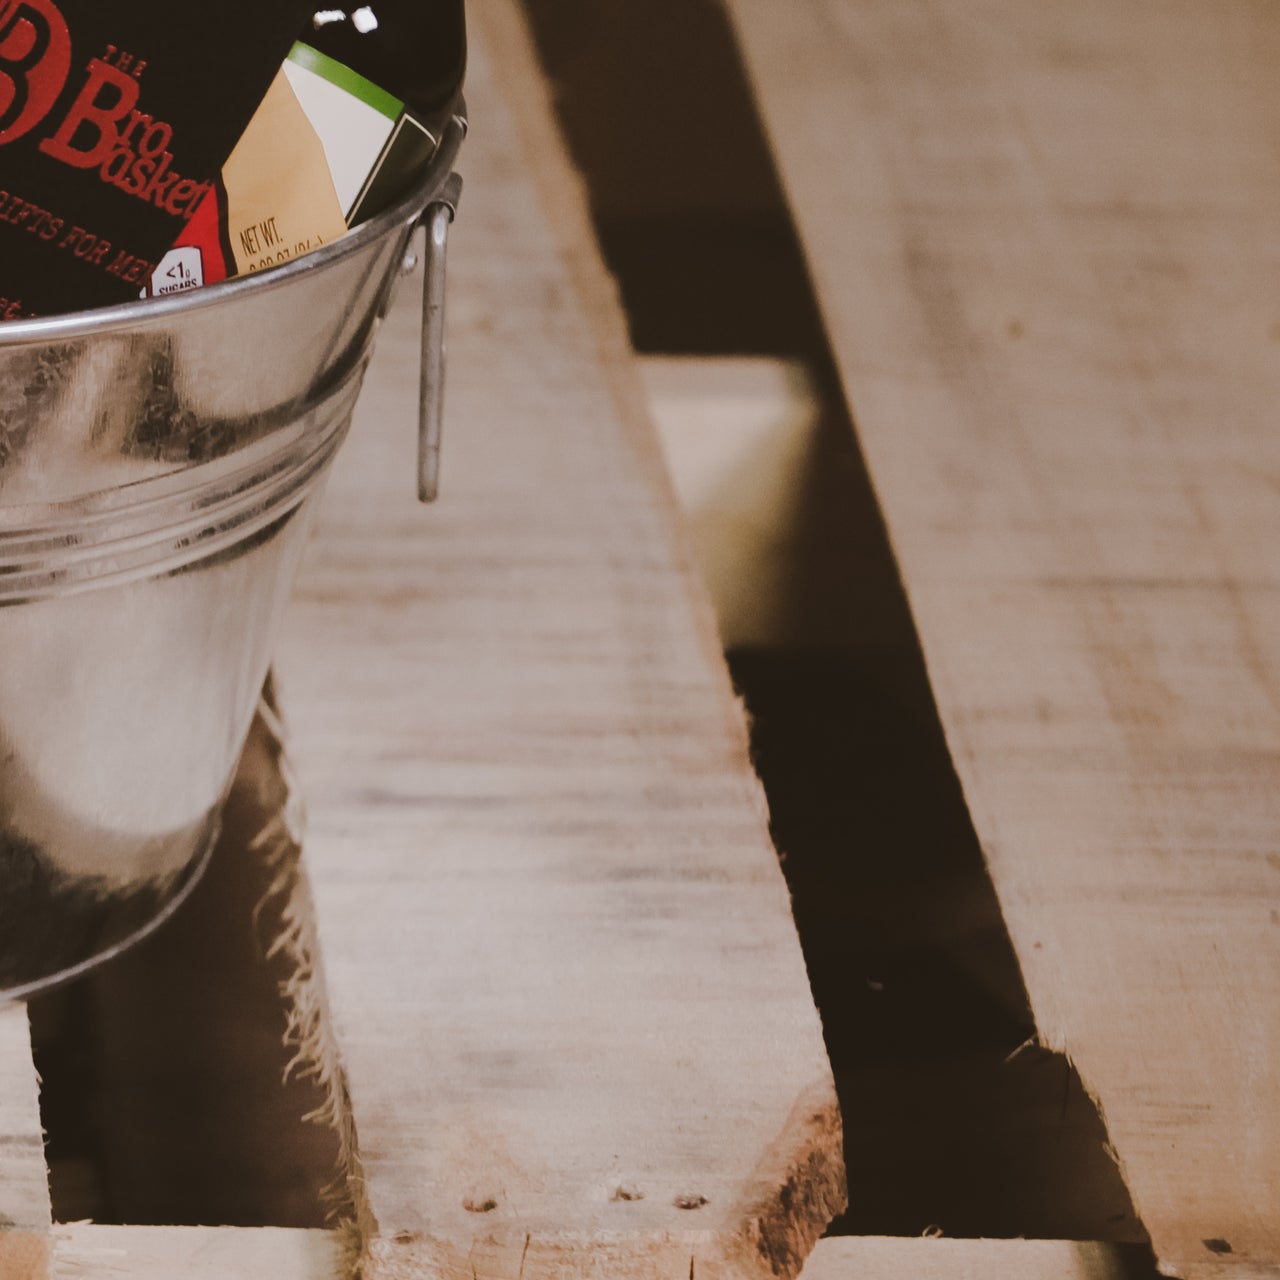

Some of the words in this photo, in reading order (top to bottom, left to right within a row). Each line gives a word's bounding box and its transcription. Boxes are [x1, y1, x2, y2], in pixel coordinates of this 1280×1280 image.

[102, 44, 148, 77] THE
[60, 224, 112, 266] FOR
[239, 226, 262, 258] NET
[259, 217, 284, 248] WT.
